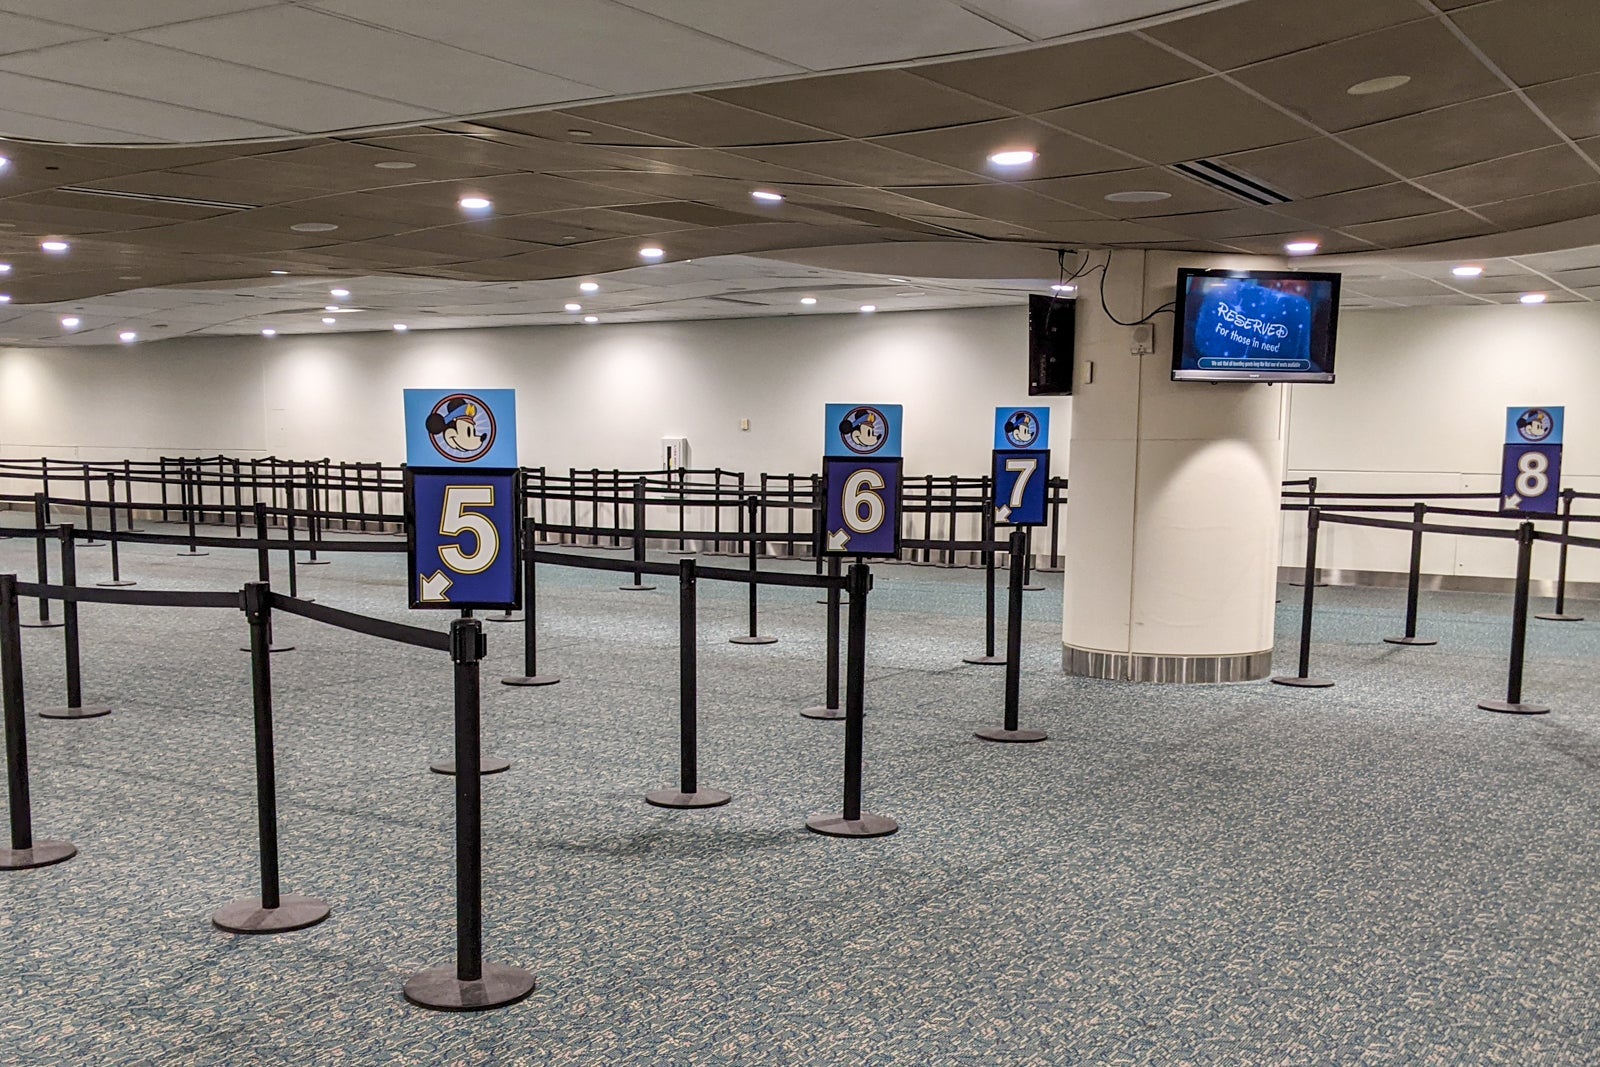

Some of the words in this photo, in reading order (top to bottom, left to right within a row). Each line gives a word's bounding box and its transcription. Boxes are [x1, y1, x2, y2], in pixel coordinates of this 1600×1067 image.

[1215, 322, 1229, 337] For
[1230, 330, 1251, 345] those
[1252, 337, 1260, 348] in
[1261, 342, 1281, 353] need
[1217, 302, 1288, 338] RESERVED
[1005, 458, 1037, 508] 7
[1515, 452, 1549, 498] 8
[841, 468, 885, 534] 6
[438, 485, 500, 575] 5
